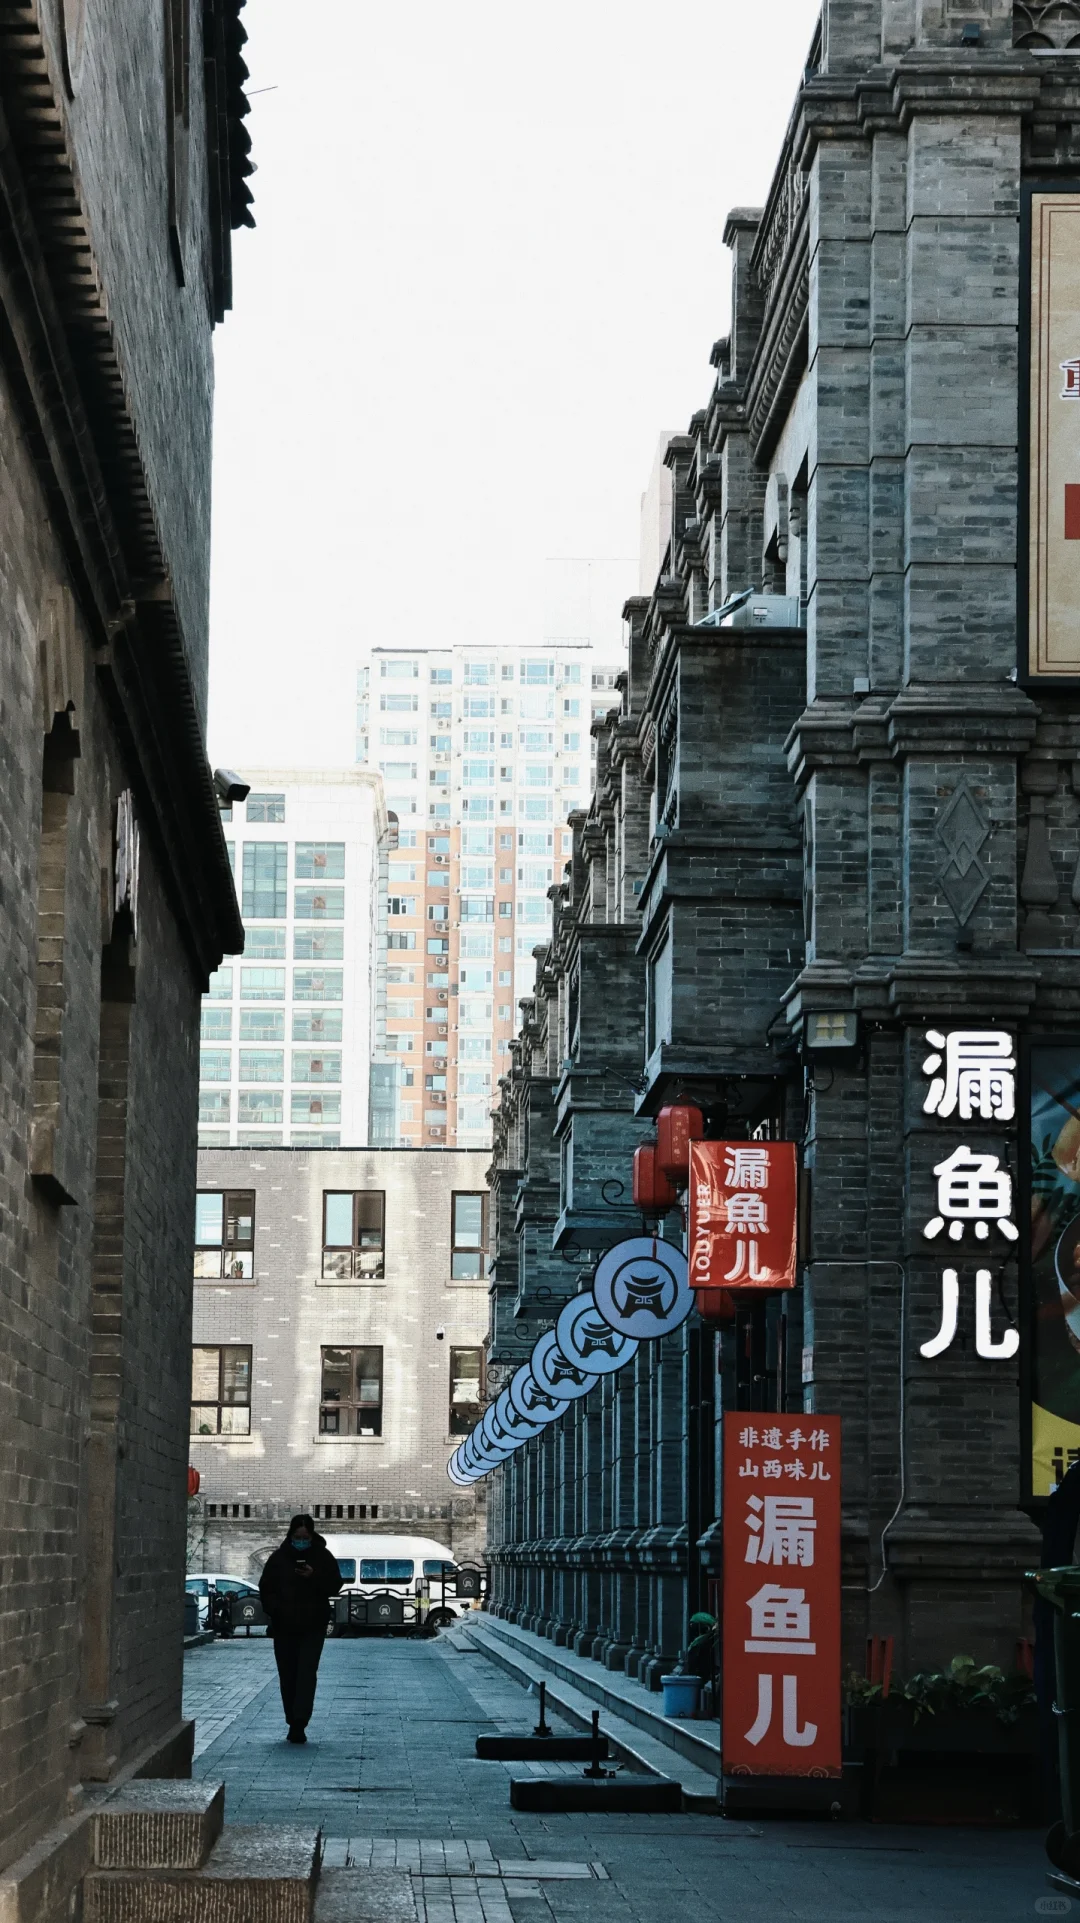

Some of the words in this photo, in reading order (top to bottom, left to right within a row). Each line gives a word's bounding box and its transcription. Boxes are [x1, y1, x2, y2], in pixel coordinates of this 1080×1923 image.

[696, 1183, 711, 1281] LOUYUER
[724, 1146, 771, 1281] 漏魚儿
[920, 1030, 1020, 1358] 漏魚儿
[738, 1426, 830, 1452] 非遗手作
[738, 1458, 831, 1481] 山西味儿
[744, 1494, 817, 1747] 漏鱼儿
